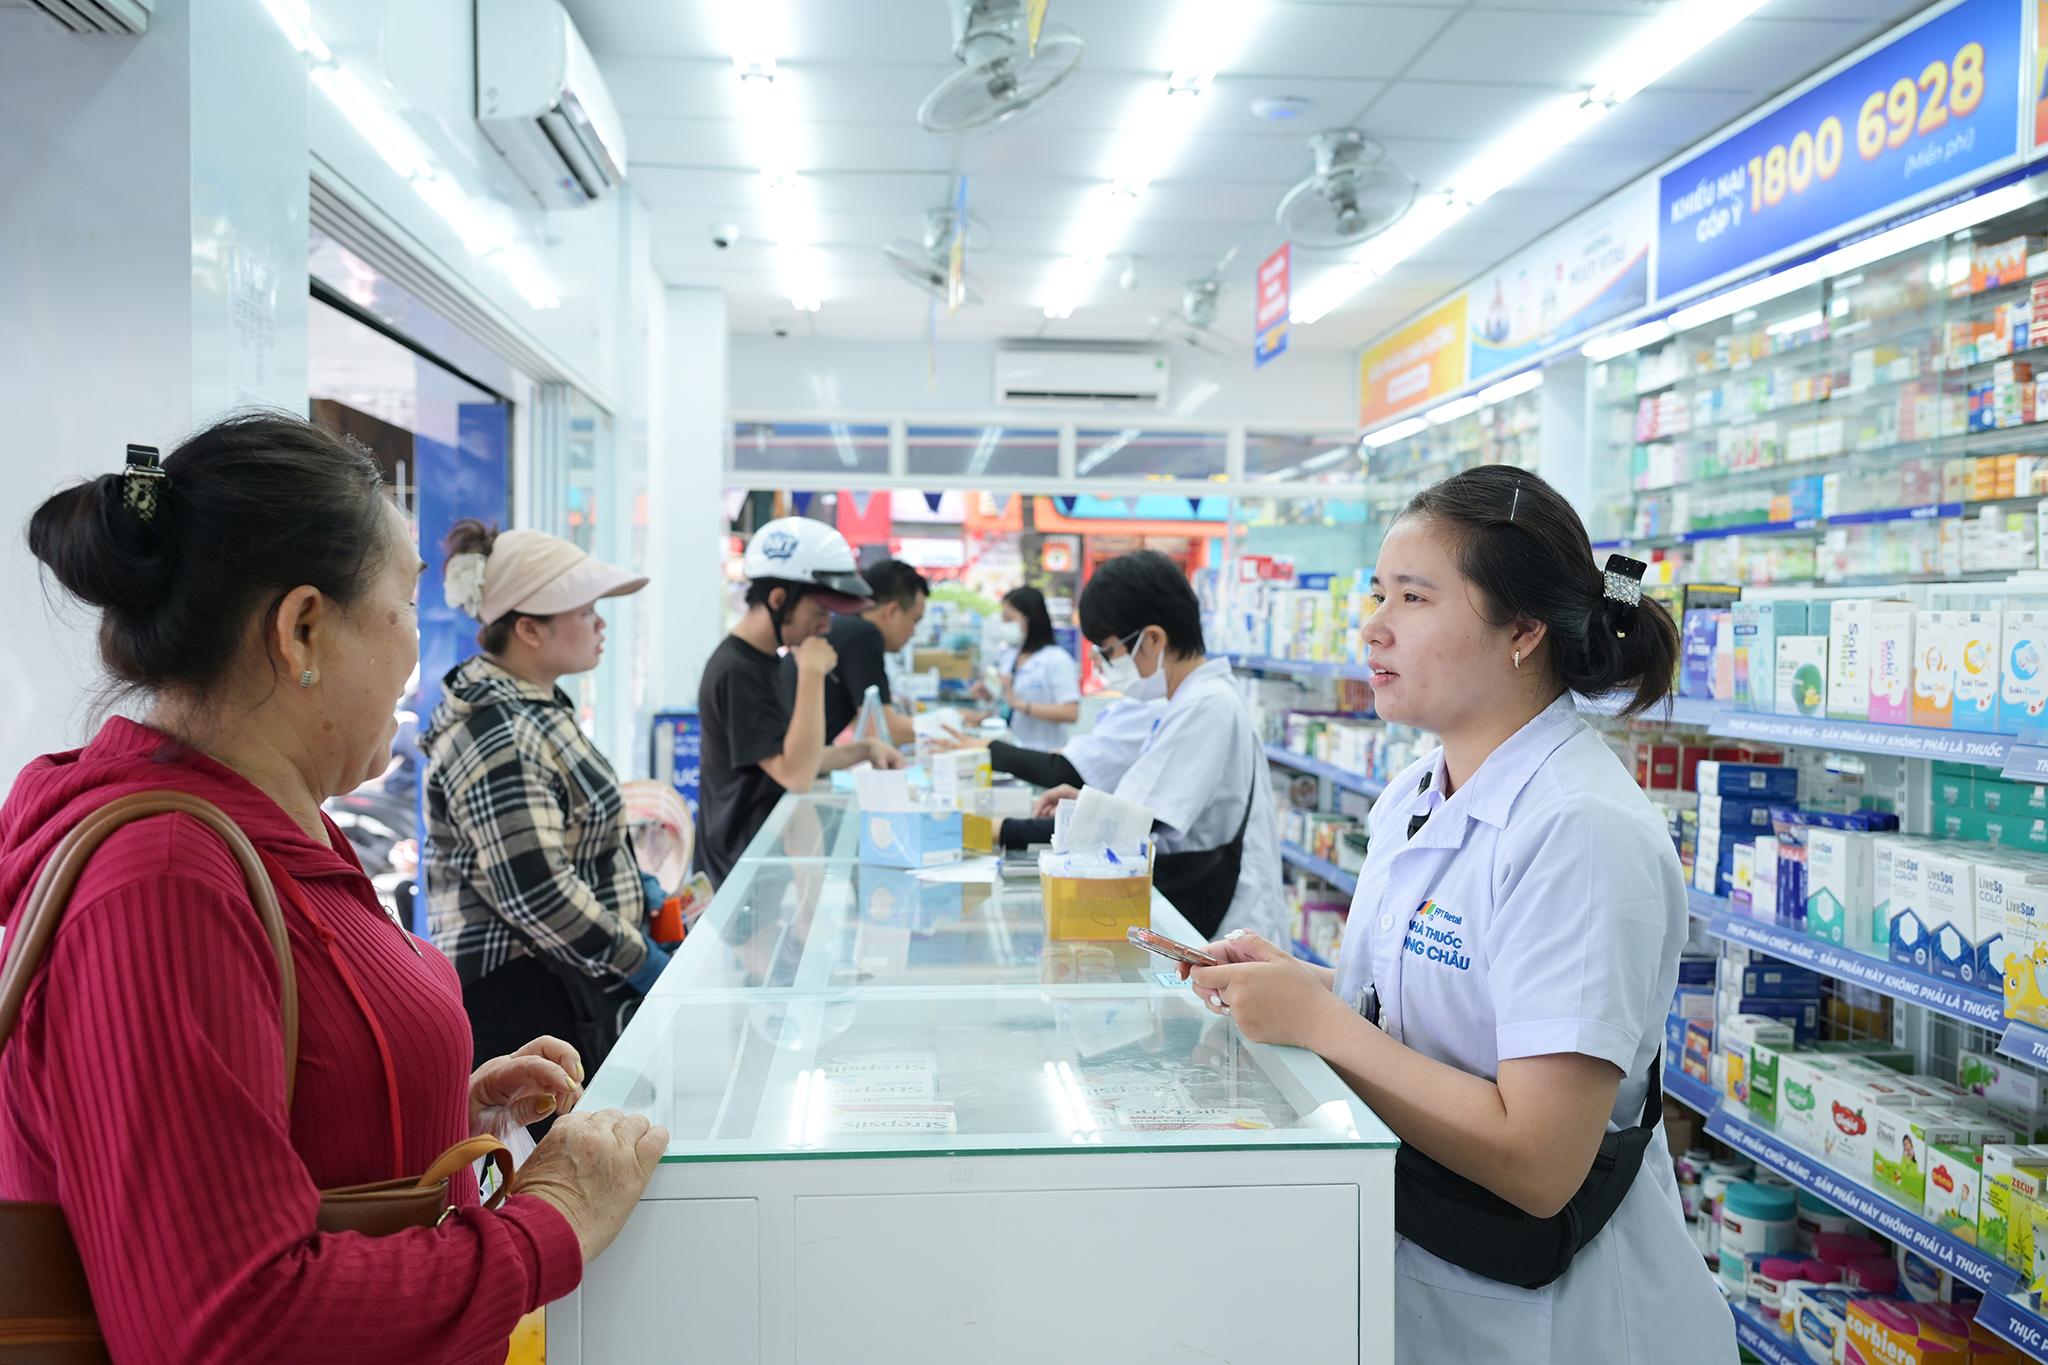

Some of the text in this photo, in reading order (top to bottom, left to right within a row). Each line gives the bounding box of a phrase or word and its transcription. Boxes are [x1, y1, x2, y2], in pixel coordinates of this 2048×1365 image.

[1748, 41, 1985, 213] 1800 6928
[1887, 734, 1921, 749] KHÔNG
[1923, 736, 1949, 752] PHẢI
[1949, 739, 1963, 754] LÀ
[1966, 739, 2004, 758] THUỐC
[1927, 870, 1953, 884] LiveSpo
[1928, 881, 1954, 895] COLON
[1444, 912, 1463, 925] Retail
[2005, 898, 2035, 917] LiveSpo
[1425, 926, 1463, 949] THUỐC
[1426, 945, 1471, 971] CHÂU
[1836, 957, 1865, 976] PHẨM
[1864, 965, 1886, 983] NÀY
[1884, 973, 1920, 996] KHÔNG
[1919, 985, 1946, 1004] PHẢI
[1945, 994, 1961, 1010] LÀ
[1962, 999, 2001, 1022] THUỐC
[1814, 1175, 1833, 1195] SẢN
[1832, 1186, 1860, 1209] PHẨM
[1859, 1200, 1880, 1219] NÀY
[1879, 1213, 1915, 1240] KHÔNG
[1913, 1231, 1940, 1255] PHẢI
[1939, 1244, 1953, 1263] LÀ
[1955, 1254, 1993, 1284] THUỐC
[2008, 1317, 2041, 1347] THỰC
